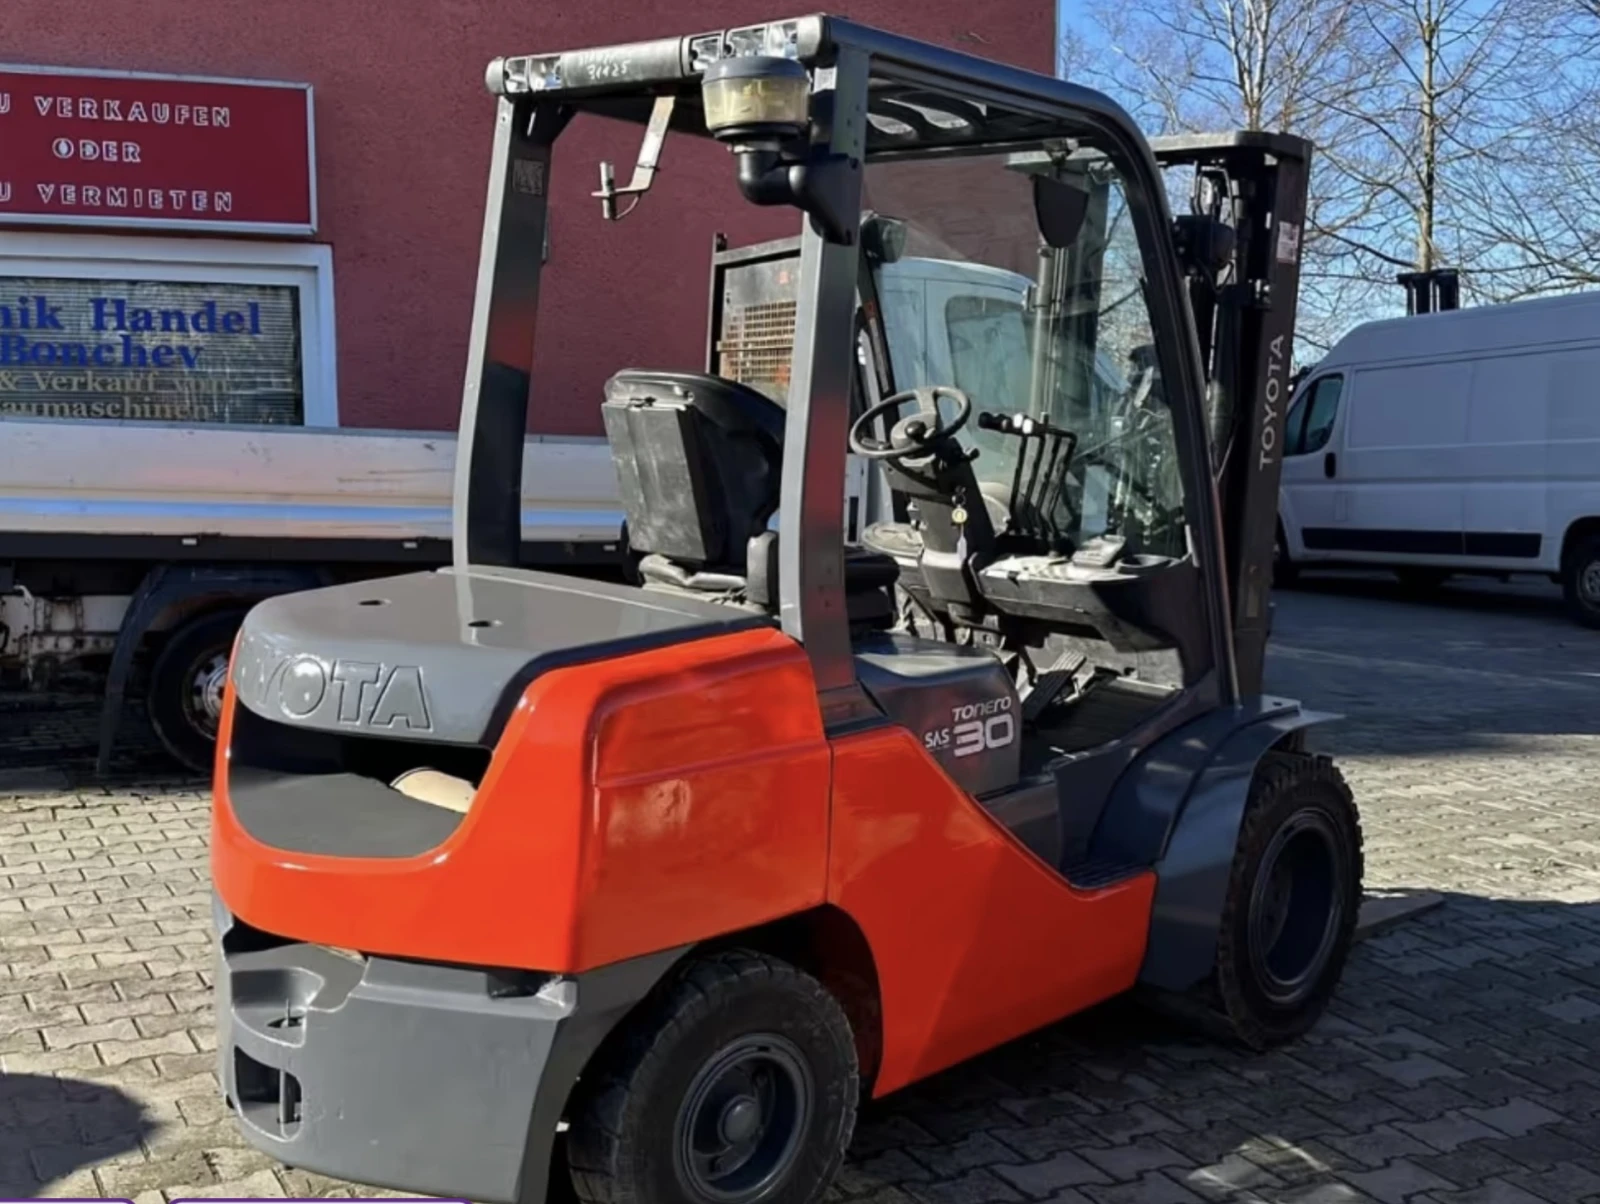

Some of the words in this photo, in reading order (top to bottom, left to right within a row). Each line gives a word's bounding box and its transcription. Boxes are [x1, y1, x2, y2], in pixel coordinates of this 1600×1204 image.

[34, 95, 231, 127] VERKAUFEN
[52, 137, 141, 163] ODER
[37, 183, 232, 212] VERMIETEN
[89, 297, 262, 334] Handel
[0, 333, 204, 369] Bonchev
[32, 371, 158, 393] Verkauf
[1259, 334, 1284, 472] TOYOTA
[953, 713, 1014, 757] 30
